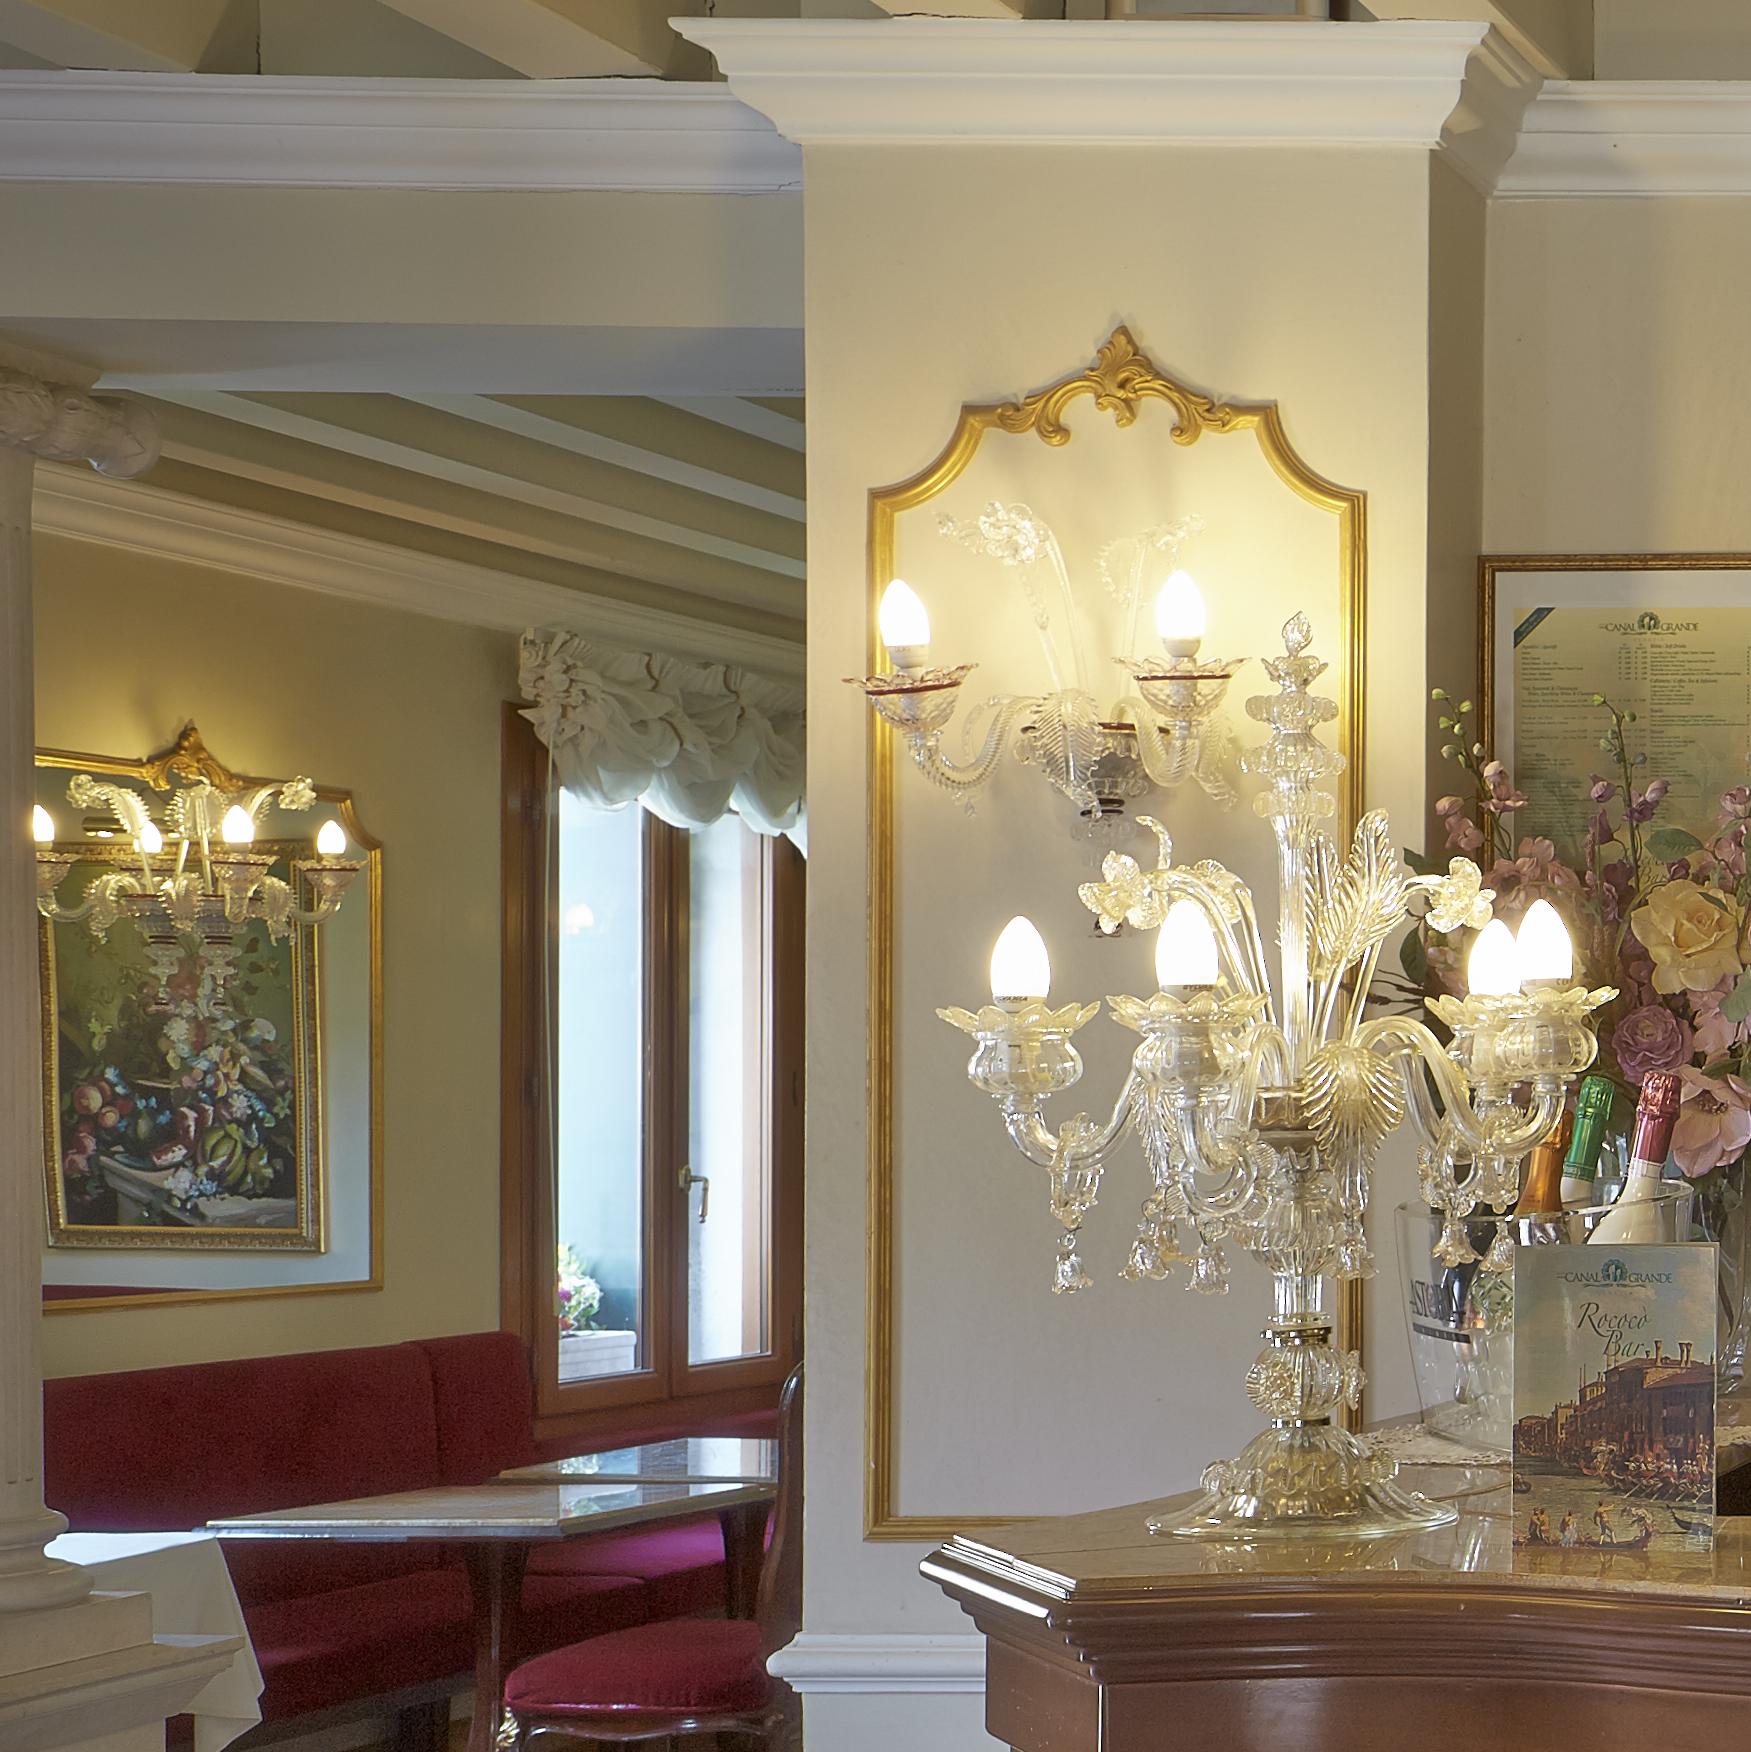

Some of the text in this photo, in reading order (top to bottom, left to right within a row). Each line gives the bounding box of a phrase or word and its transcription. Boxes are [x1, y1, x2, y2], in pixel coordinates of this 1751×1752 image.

[1605, 623, 1699, 631] CANAL GRANDE
[1565, 1272, 1673, 1284] CANAL GRANDE
[1577, 1302, 1648, 1337] Rococò
[1603, 1329, 1644, 1357] Bar
